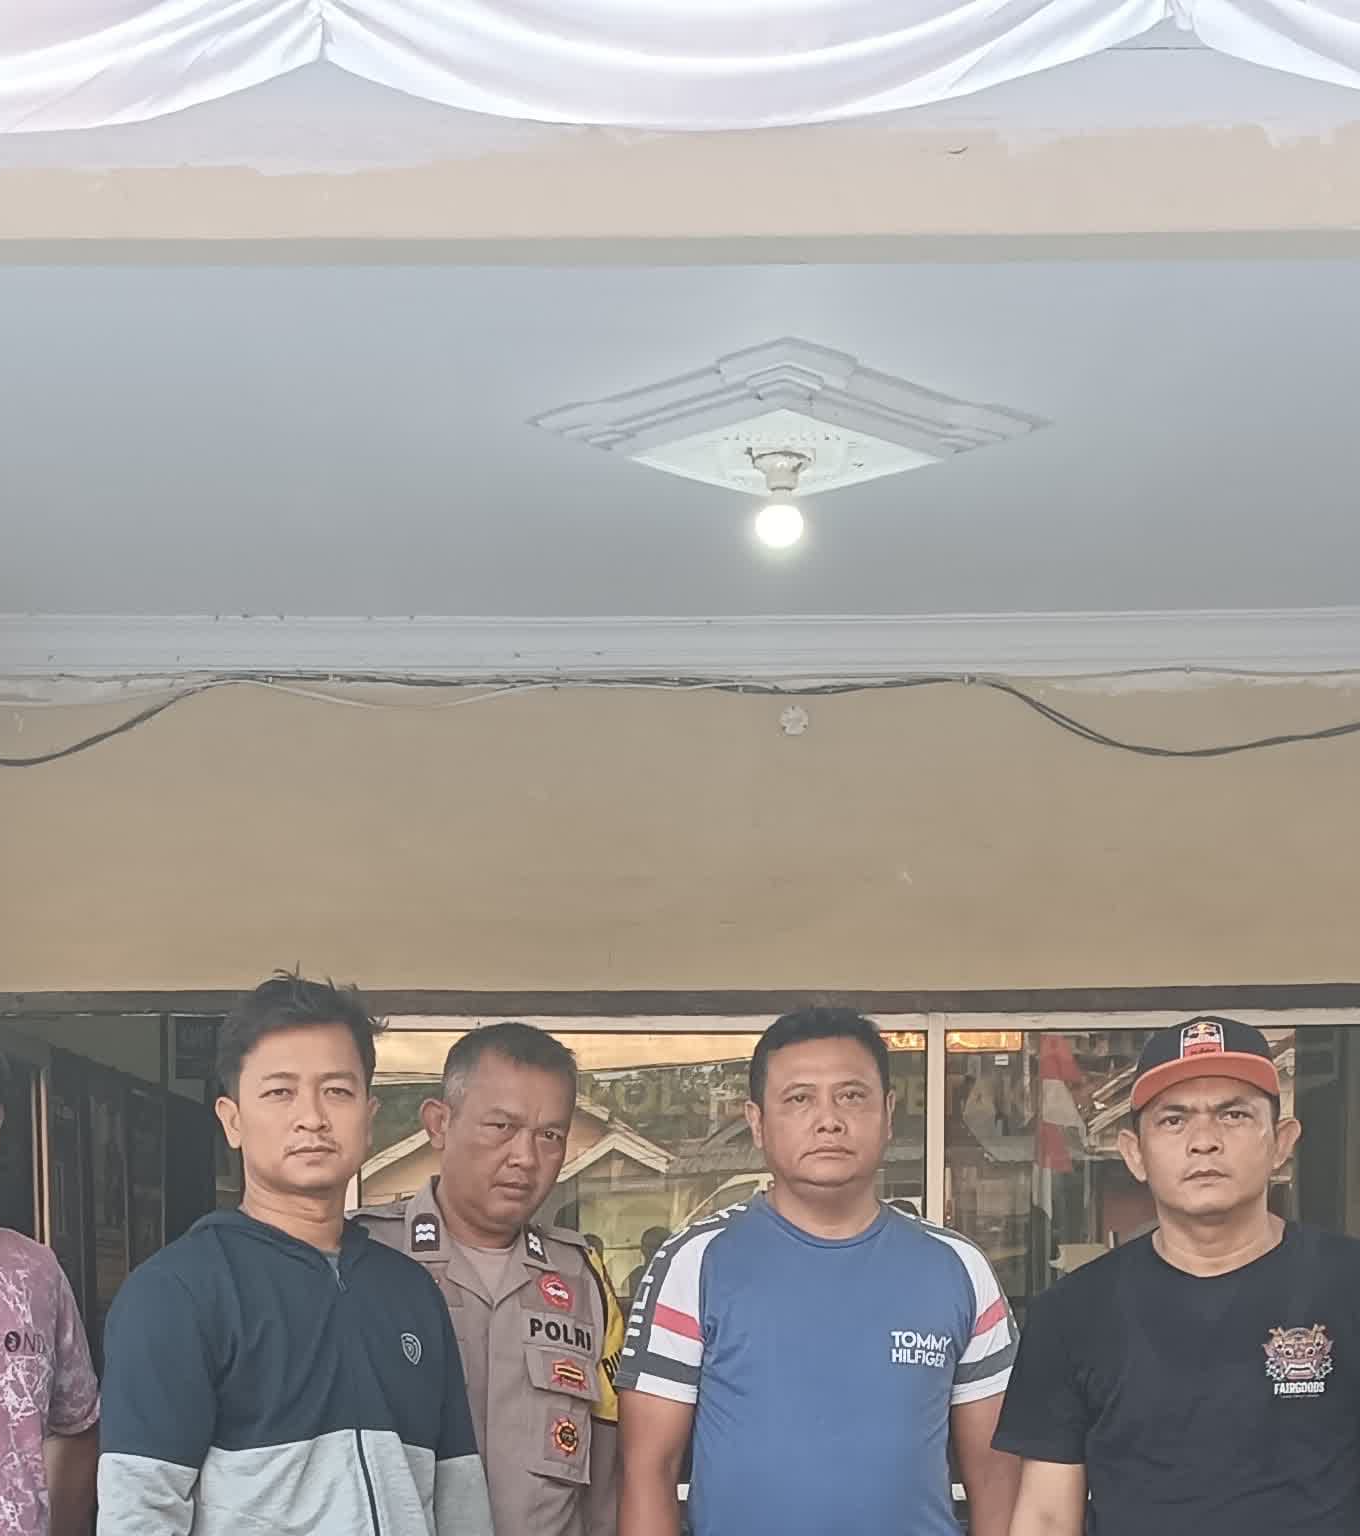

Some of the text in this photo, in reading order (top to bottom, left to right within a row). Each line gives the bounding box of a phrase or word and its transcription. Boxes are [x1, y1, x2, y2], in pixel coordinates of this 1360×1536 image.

[529, 1317, 592, 1351] POLRI
[890, 1330, 953, 1353] TOMMY
[891, 1348, 946, 1368] HILFIGER
